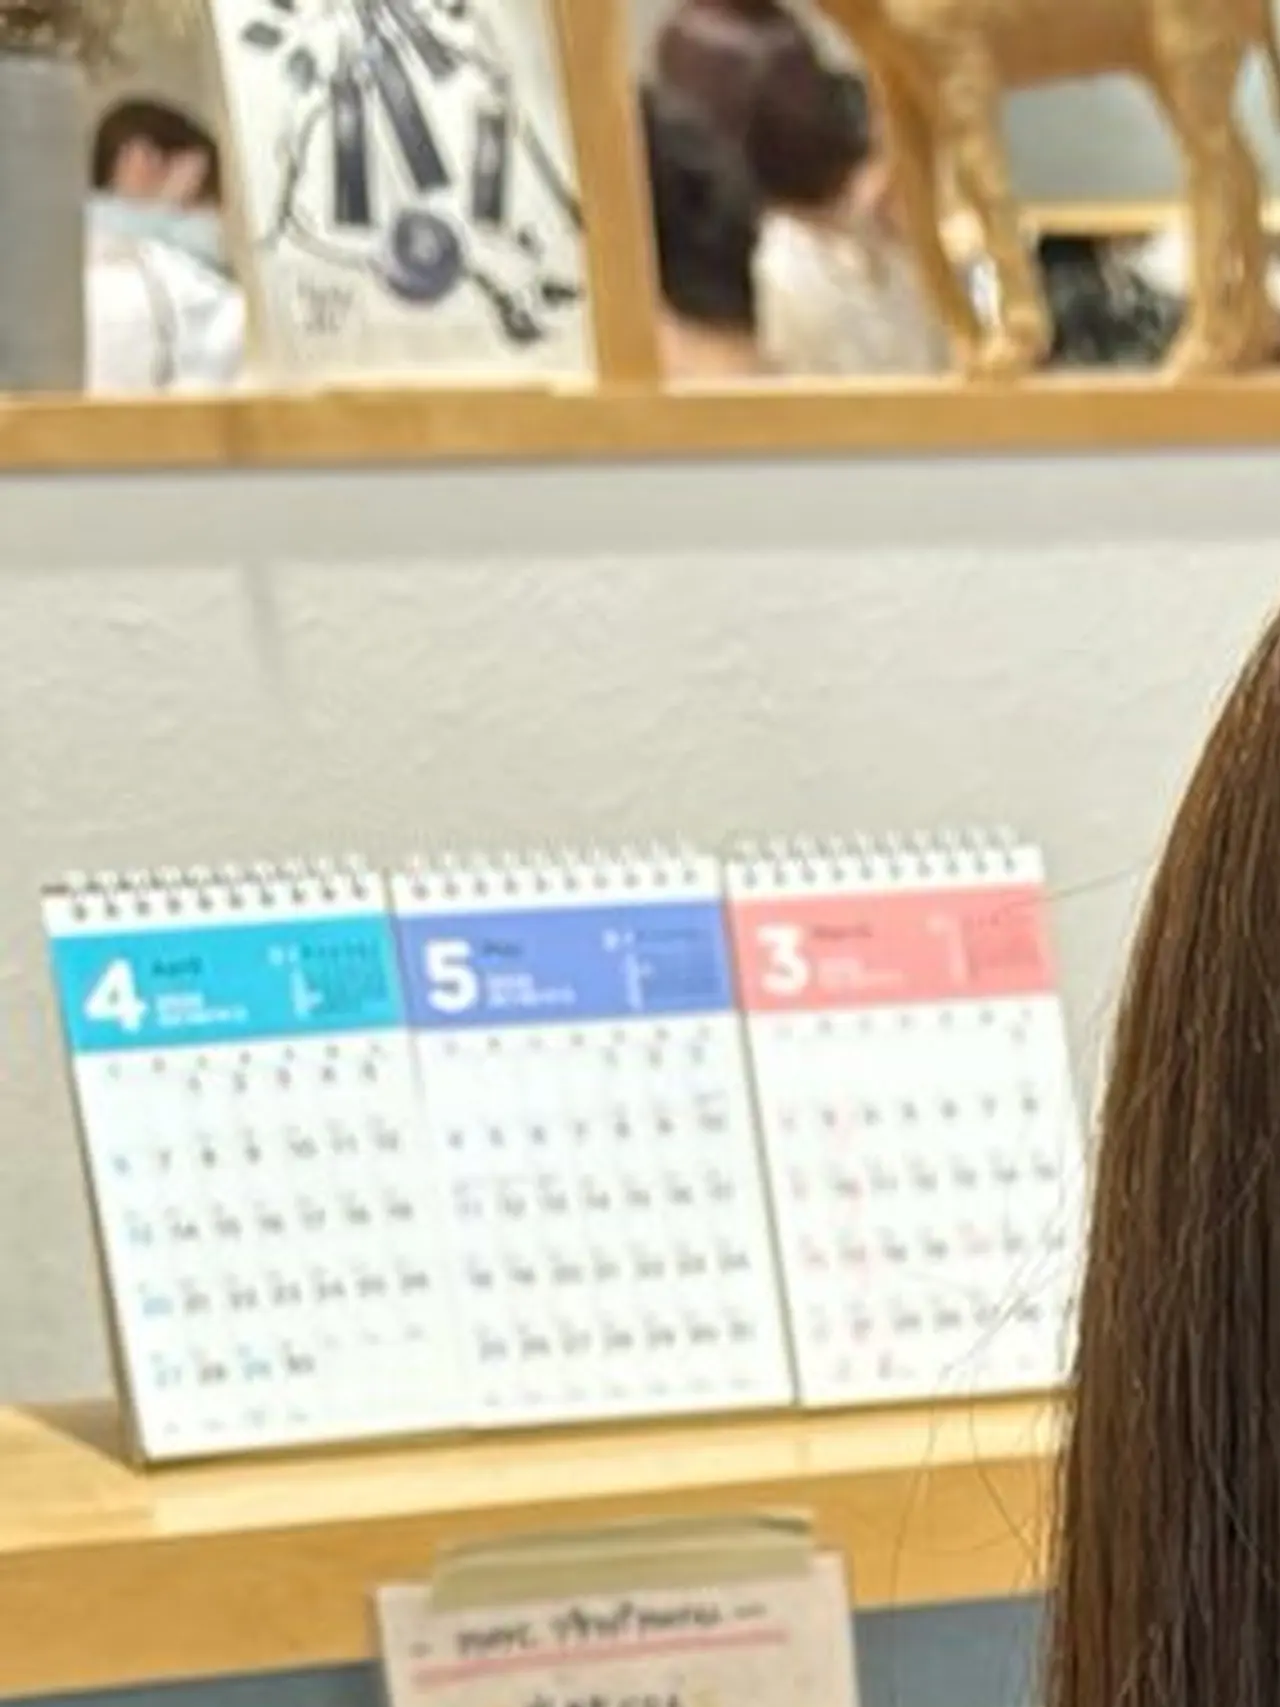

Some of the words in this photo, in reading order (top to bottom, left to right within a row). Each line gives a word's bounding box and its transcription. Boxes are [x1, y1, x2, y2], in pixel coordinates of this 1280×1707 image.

[82, 957, 149, 1034] 4
[424, 938, 479, 1014] 5
[757, 924, 810, 997] 3
